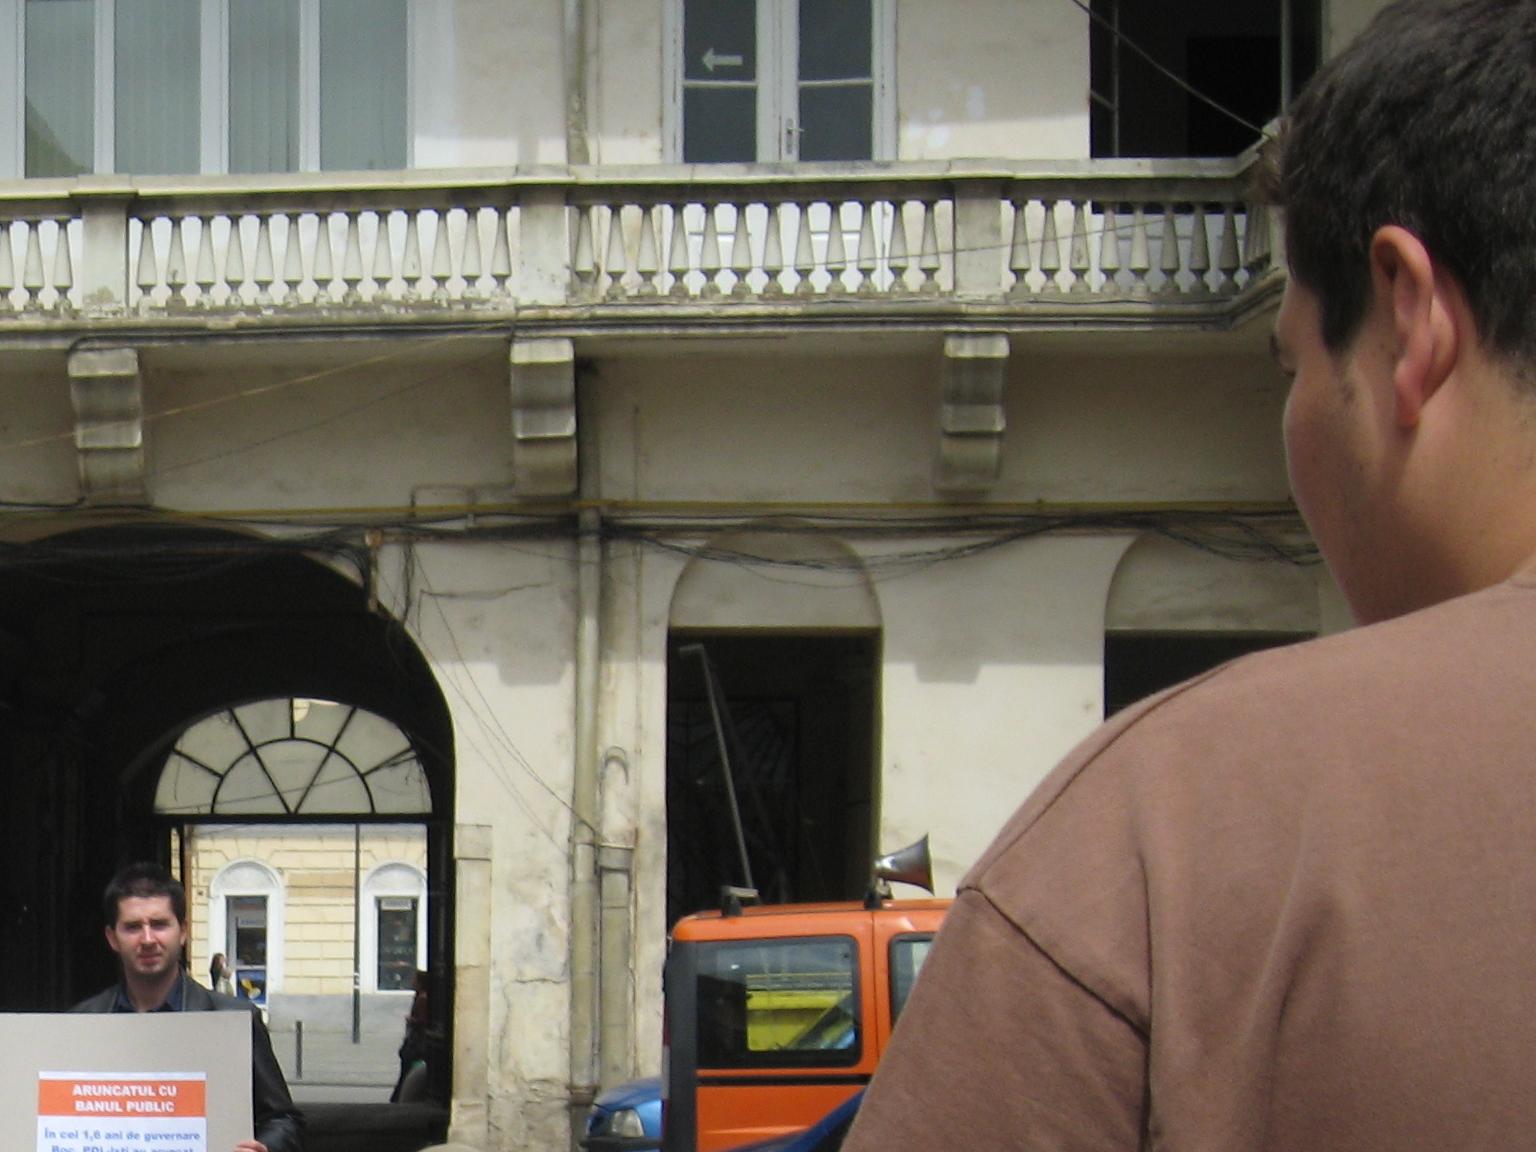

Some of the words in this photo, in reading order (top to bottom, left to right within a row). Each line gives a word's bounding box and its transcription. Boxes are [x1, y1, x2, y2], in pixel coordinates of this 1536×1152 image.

[72, 1084, 156, 1097] ARUNCATUL
[158, 1085, 177, 1097] CU
[74, 1100, 123, 1112] BANUL
[126, 1101, 175, 1113] PUBLIC
[44, 1127, 57, 1139] În
[105, 1130, 123, 1140] ani
[126, 1130, 141, 1140] de
[144, 1132, 200, 1142] guvernare
